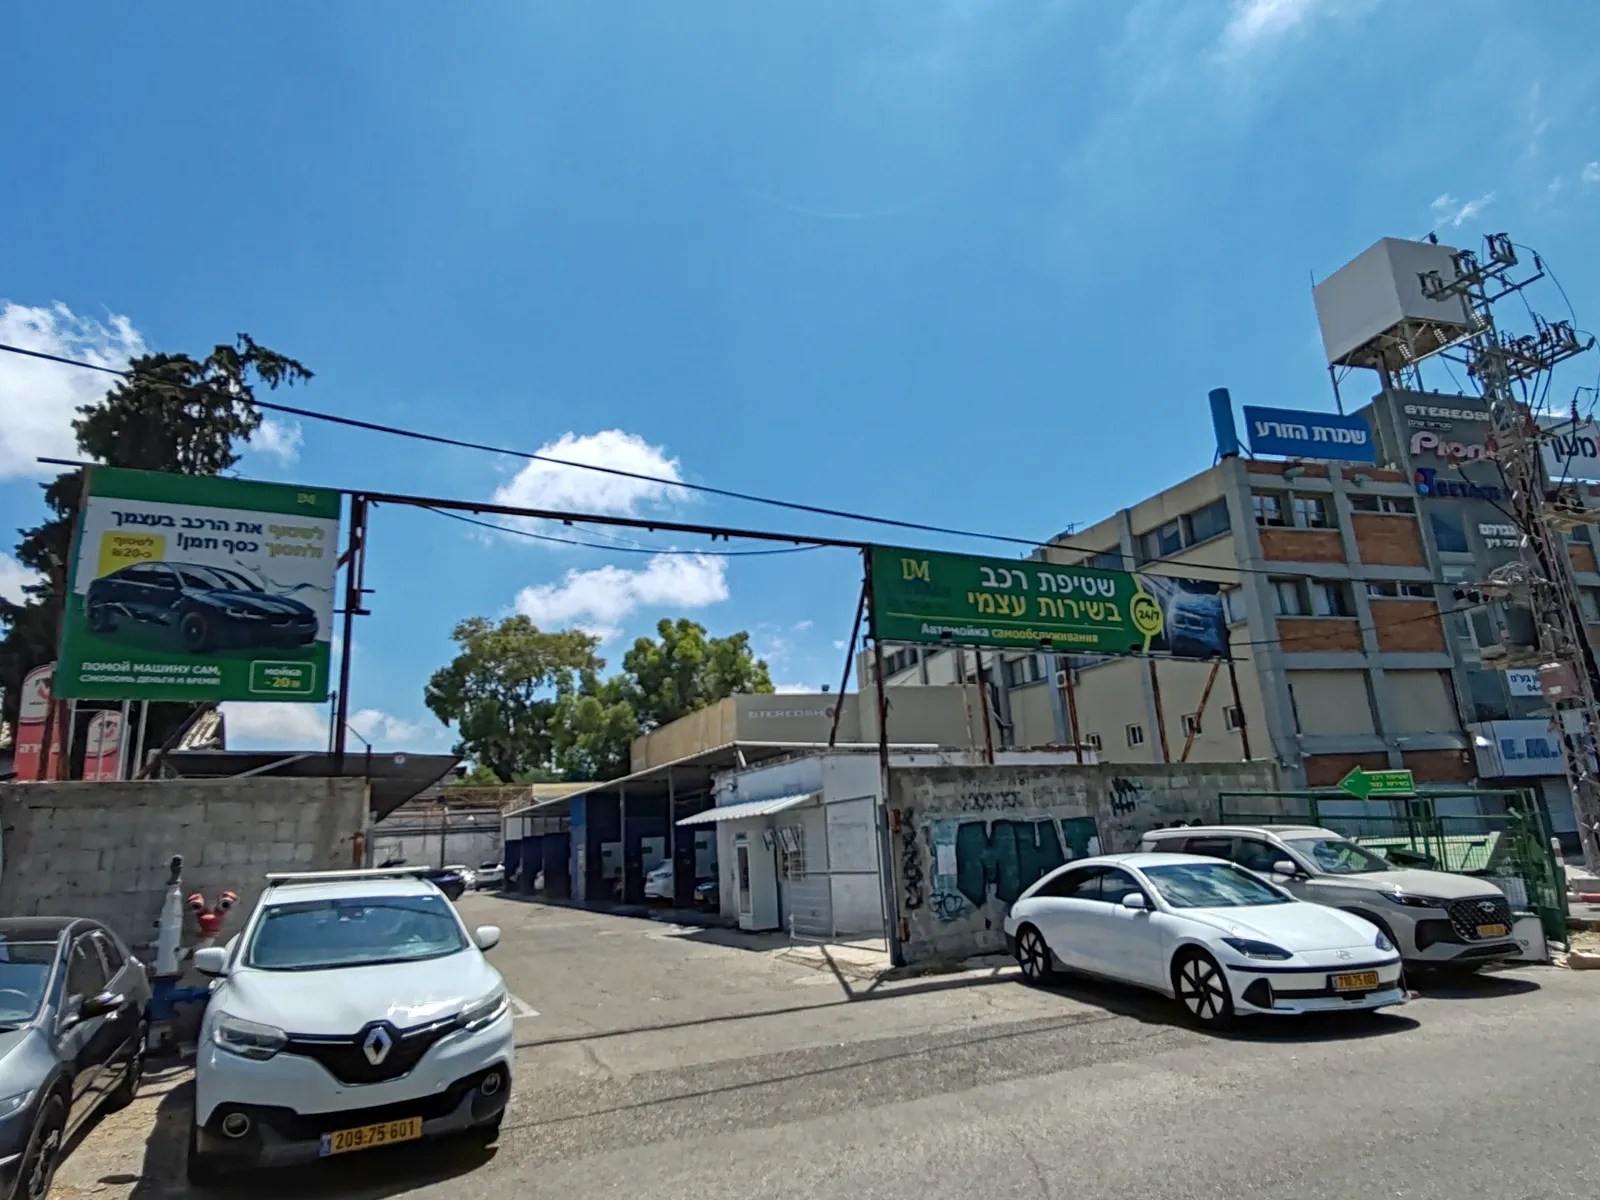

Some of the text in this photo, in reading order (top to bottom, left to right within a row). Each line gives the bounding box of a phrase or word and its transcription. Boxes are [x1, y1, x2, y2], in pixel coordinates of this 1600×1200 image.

[111, 511, 175, 526] בעצמך
[182, 517, 229, 532] הרכב
[235, 520, 262, 534] את
[223, 538, 259, 553] כסף
[980, 566, 1115, 597] שטיפת רכב
[967, 591, 1122, 621] בשירות עצמי
[1138, 609, 1160, 621] 24/7
[81, 661, 130, 672] ПОМОЙ
[133, 663, 190, 674] МАШИНУ
